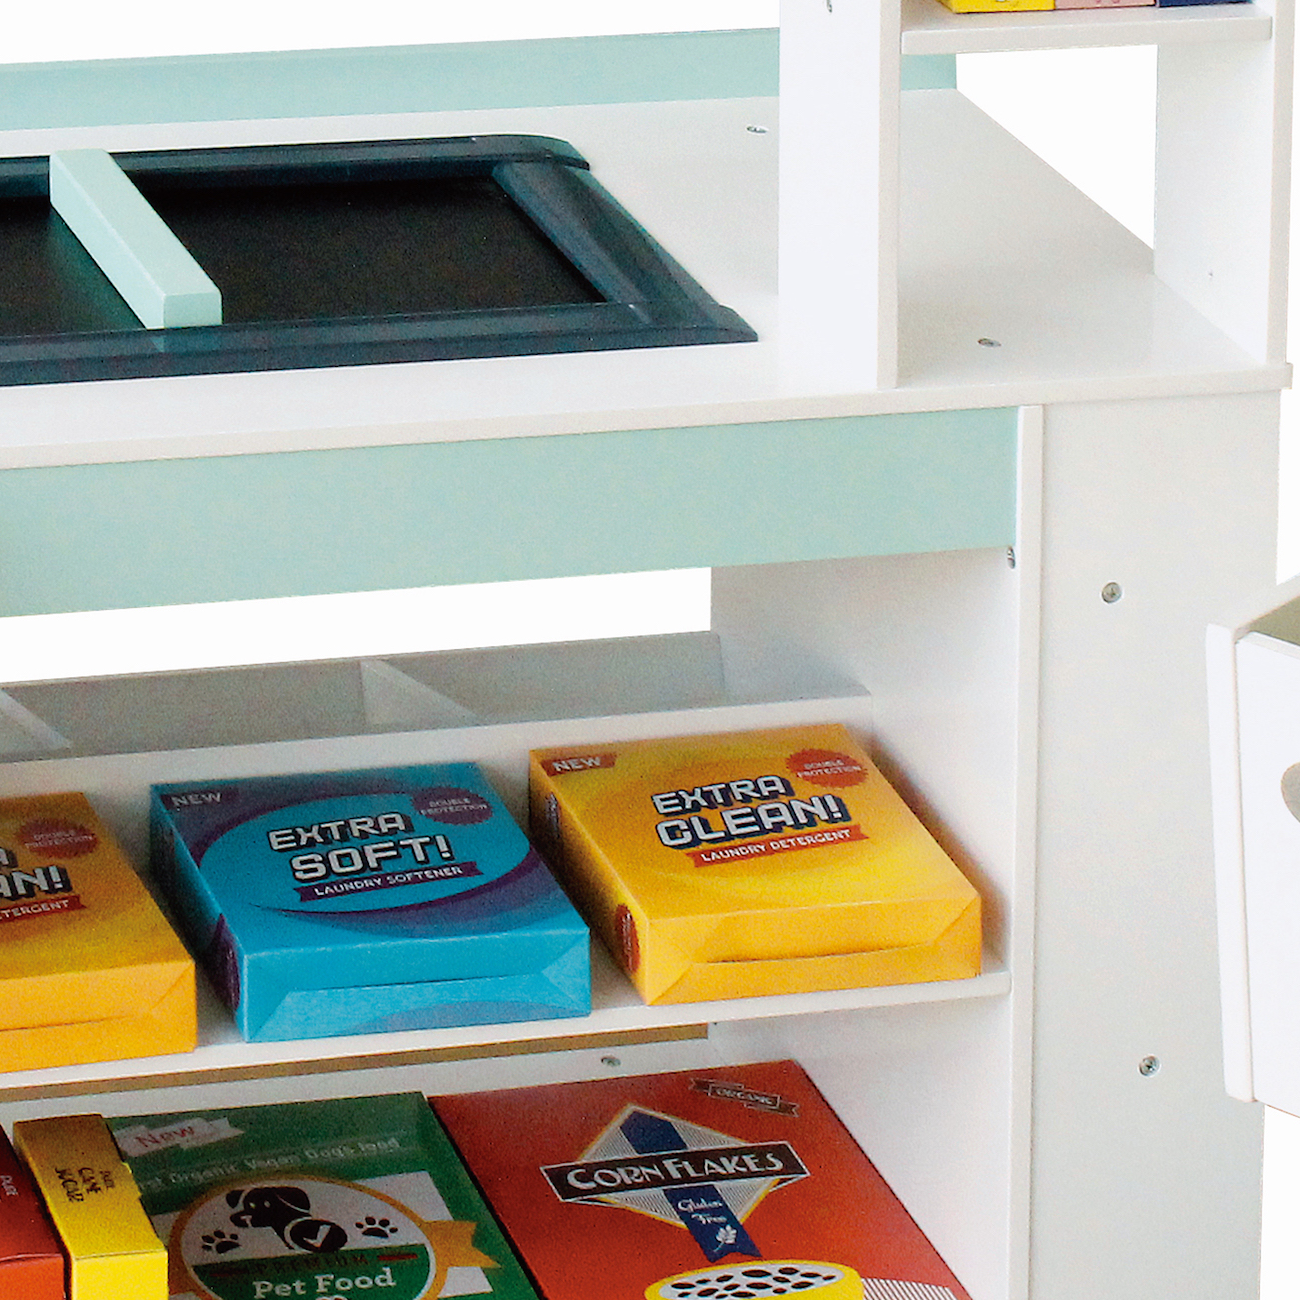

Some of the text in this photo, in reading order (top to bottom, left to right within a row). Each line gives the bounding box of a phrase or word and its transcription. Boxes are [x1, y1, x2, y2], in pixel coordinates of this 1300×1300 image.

[552, 756, 602, 772] NEW
[797, 765, 862, 778] PROTECTION
[171, 792, 223, 807] NEW
[652, 775, 787, 815] EXTRA
[268, 812, 406, 851] EXTRA
[656, 794, 843, 847] CLEAN!
[291, 835, 453, 881] SOFT!
[701, 829, 852, 862] LAUNDRY DETERGENT
[314, 865, 463, 897] LAUNDRY SOFTENER
[135, 1125, 196, 1148] New
[253, 1267, 397, 1299] Pet Food
